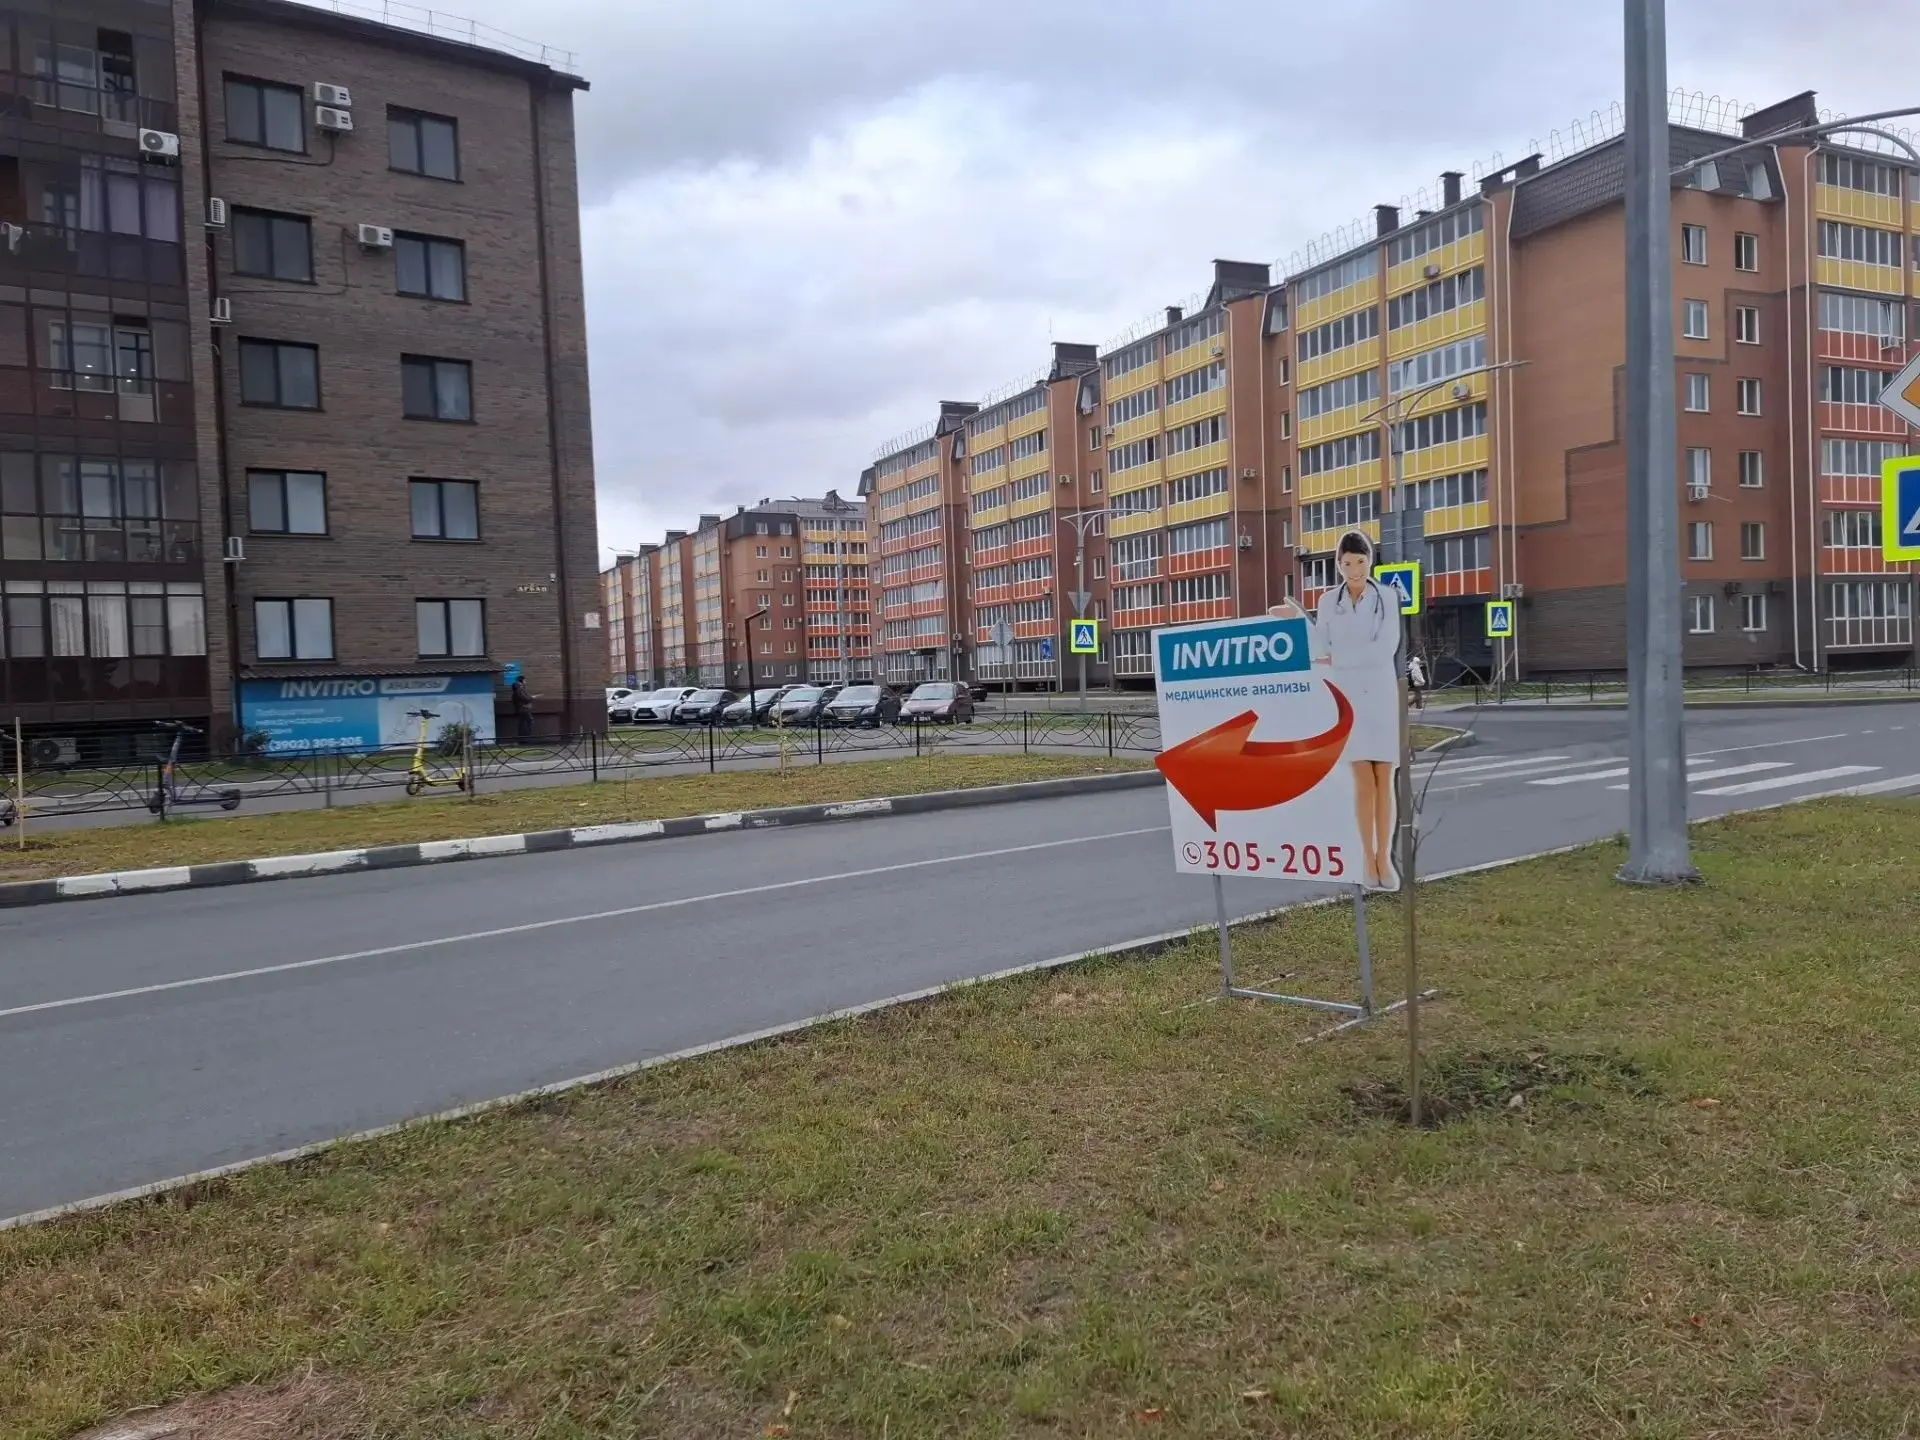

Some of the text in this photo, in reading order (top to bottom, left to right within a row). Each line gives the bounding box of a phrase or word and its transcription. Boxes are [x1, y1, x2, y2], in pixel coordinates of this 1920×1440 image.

[1172, 632, 1294, 671] INVITRO
[281, 679, 376, 699] INVITRO
[1165, 681, 1311, 702] медицинские анализы
[1203, 840, 1345, 877] 305-205
